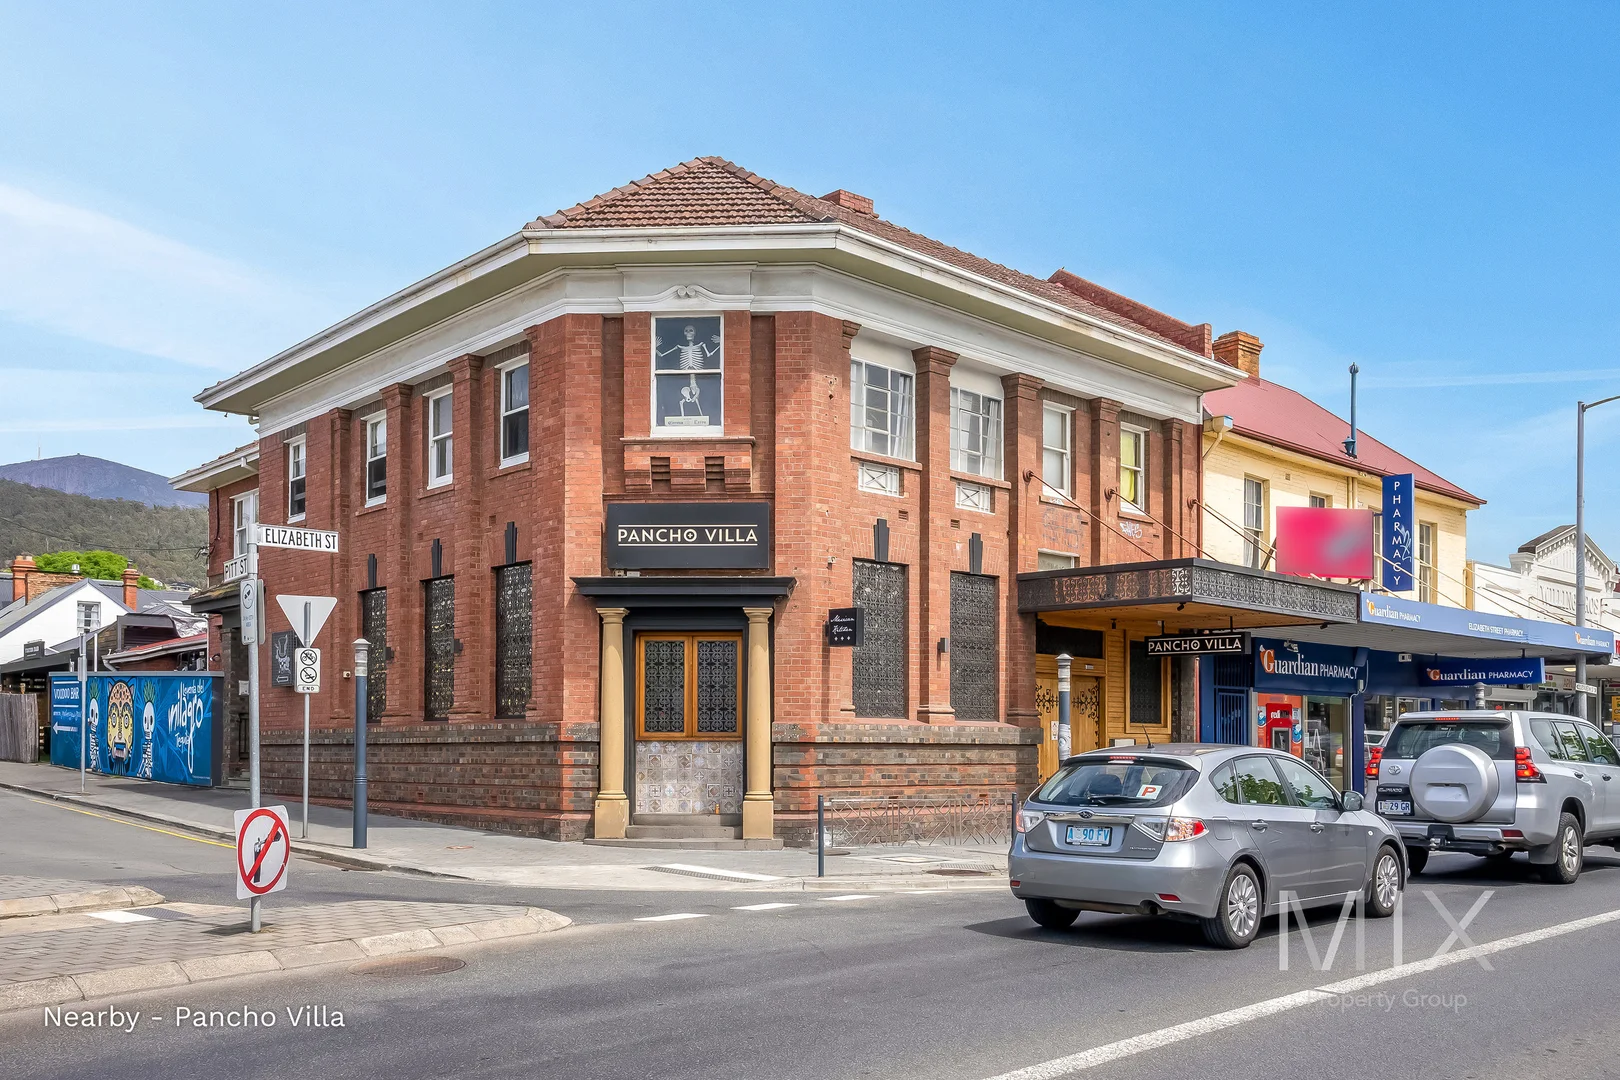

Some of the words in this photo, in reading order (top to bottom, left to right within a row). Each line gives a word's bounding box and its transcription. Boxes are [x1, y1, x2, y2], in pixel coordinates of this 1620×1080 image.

[265, 528, 322, 549] ELIZABETH
[325, 534, 337, 550] ST
[617, 528, 698, 542] PANCHO
[705, 528, 758, 542] VILLA
[1391, 481, 1402, 585] PHARMACY
[225, 562, 238, 580] PITT
[240, 558, 248, 575] ST
[1367, 601, 1399, 620] Guardian
[1399, 611, 1421, 623] PHARMACY
[1468, 622, 1490, 633] ELIZABETH
[1490, 625, 1504, 635] STREET
[1504, 627, 1524, 637] PHARMACY
[1148, 639, 1200, 652] PANCHO
[1204, 638, 1241, 649] VILLA
[1263, 649, 1319, 677] Guardian
[1319, 663, 1359, 680] PHARMACY
[1429, 668, 1487, 681] Guardian
[1488, 670, 1534, 679] PHARMACY
[1141, 786, 1157, 797] P
